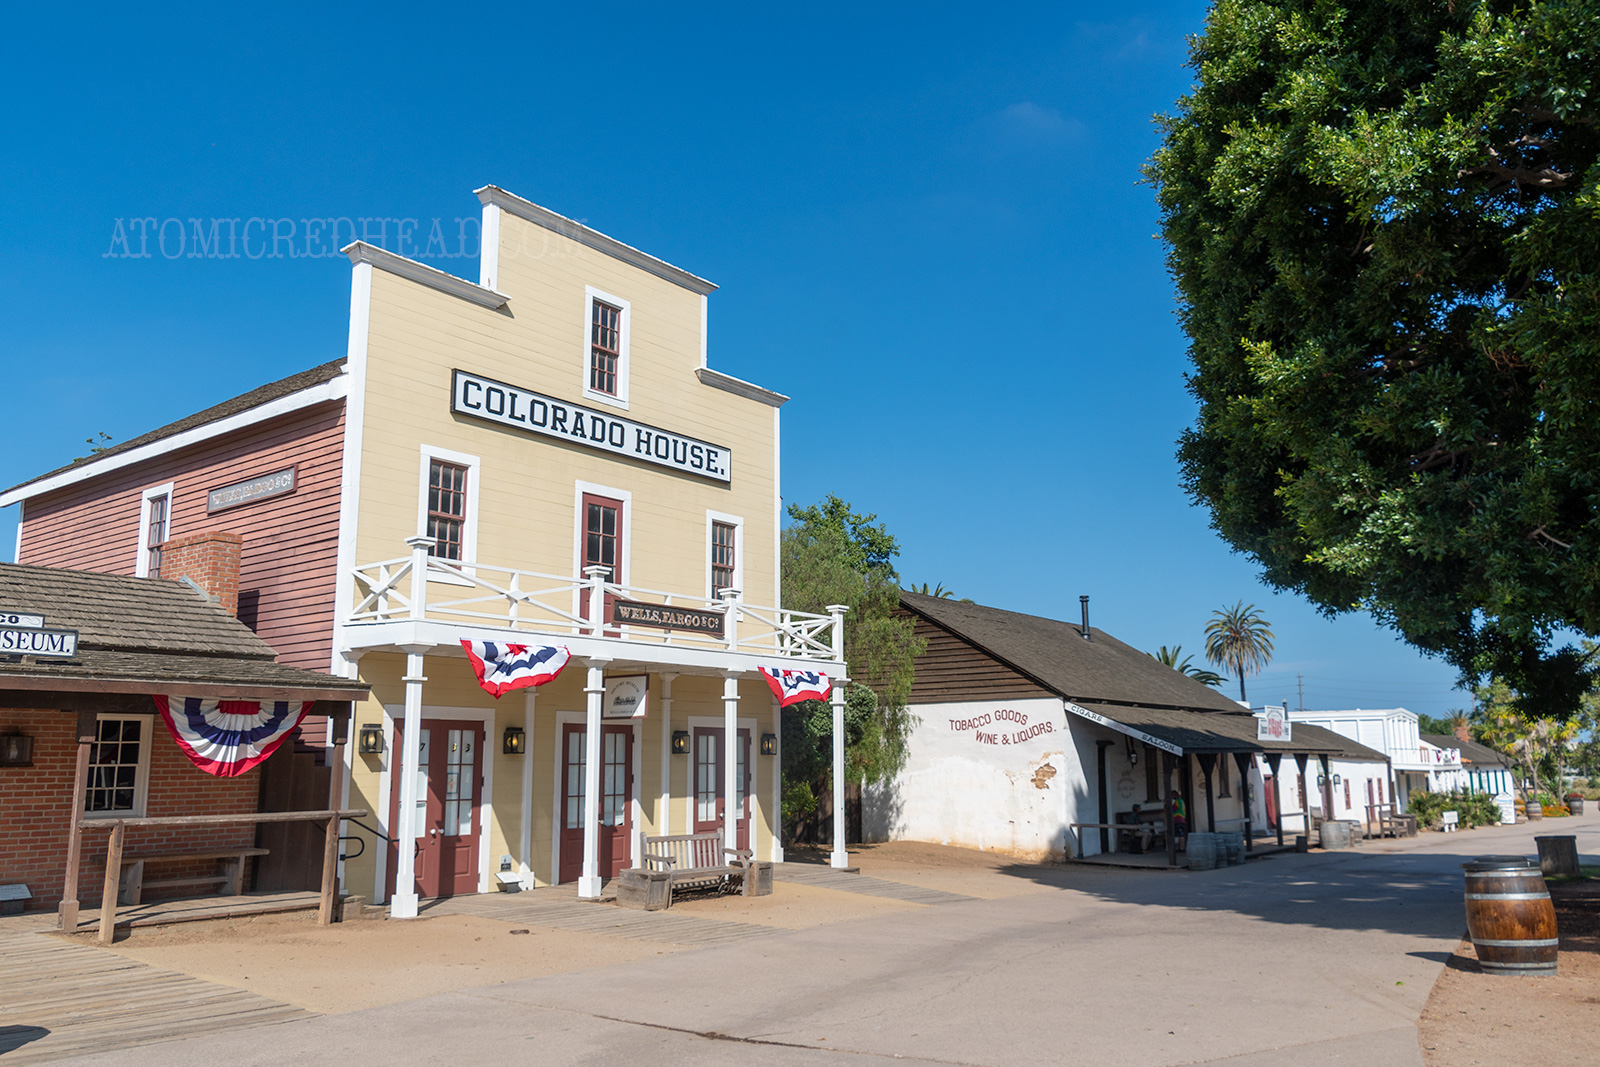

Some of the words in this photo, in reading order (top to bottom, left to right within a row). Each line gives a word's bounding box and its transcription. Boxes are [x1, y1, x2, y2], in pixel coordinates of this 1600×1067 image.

[463, 379, 625, 449] COLORADO
[635, 427, 725, 476] HOUSE.
[662, 611, 700, 627] FARGO
[0, 630, 70, 652] SEUM.
[949, 713, 992, 731] TOBACCO
[994, 709, 1028, 726] GOODS
[1071, 705, 1103, 722] CIGARS
[1141, 734, 1176, 752] SALOON
[975, 730, 999, 745] WINE
[1001, 733, 1011, 745] &
[1012, 721, 1057, 744] LIQUORS.
